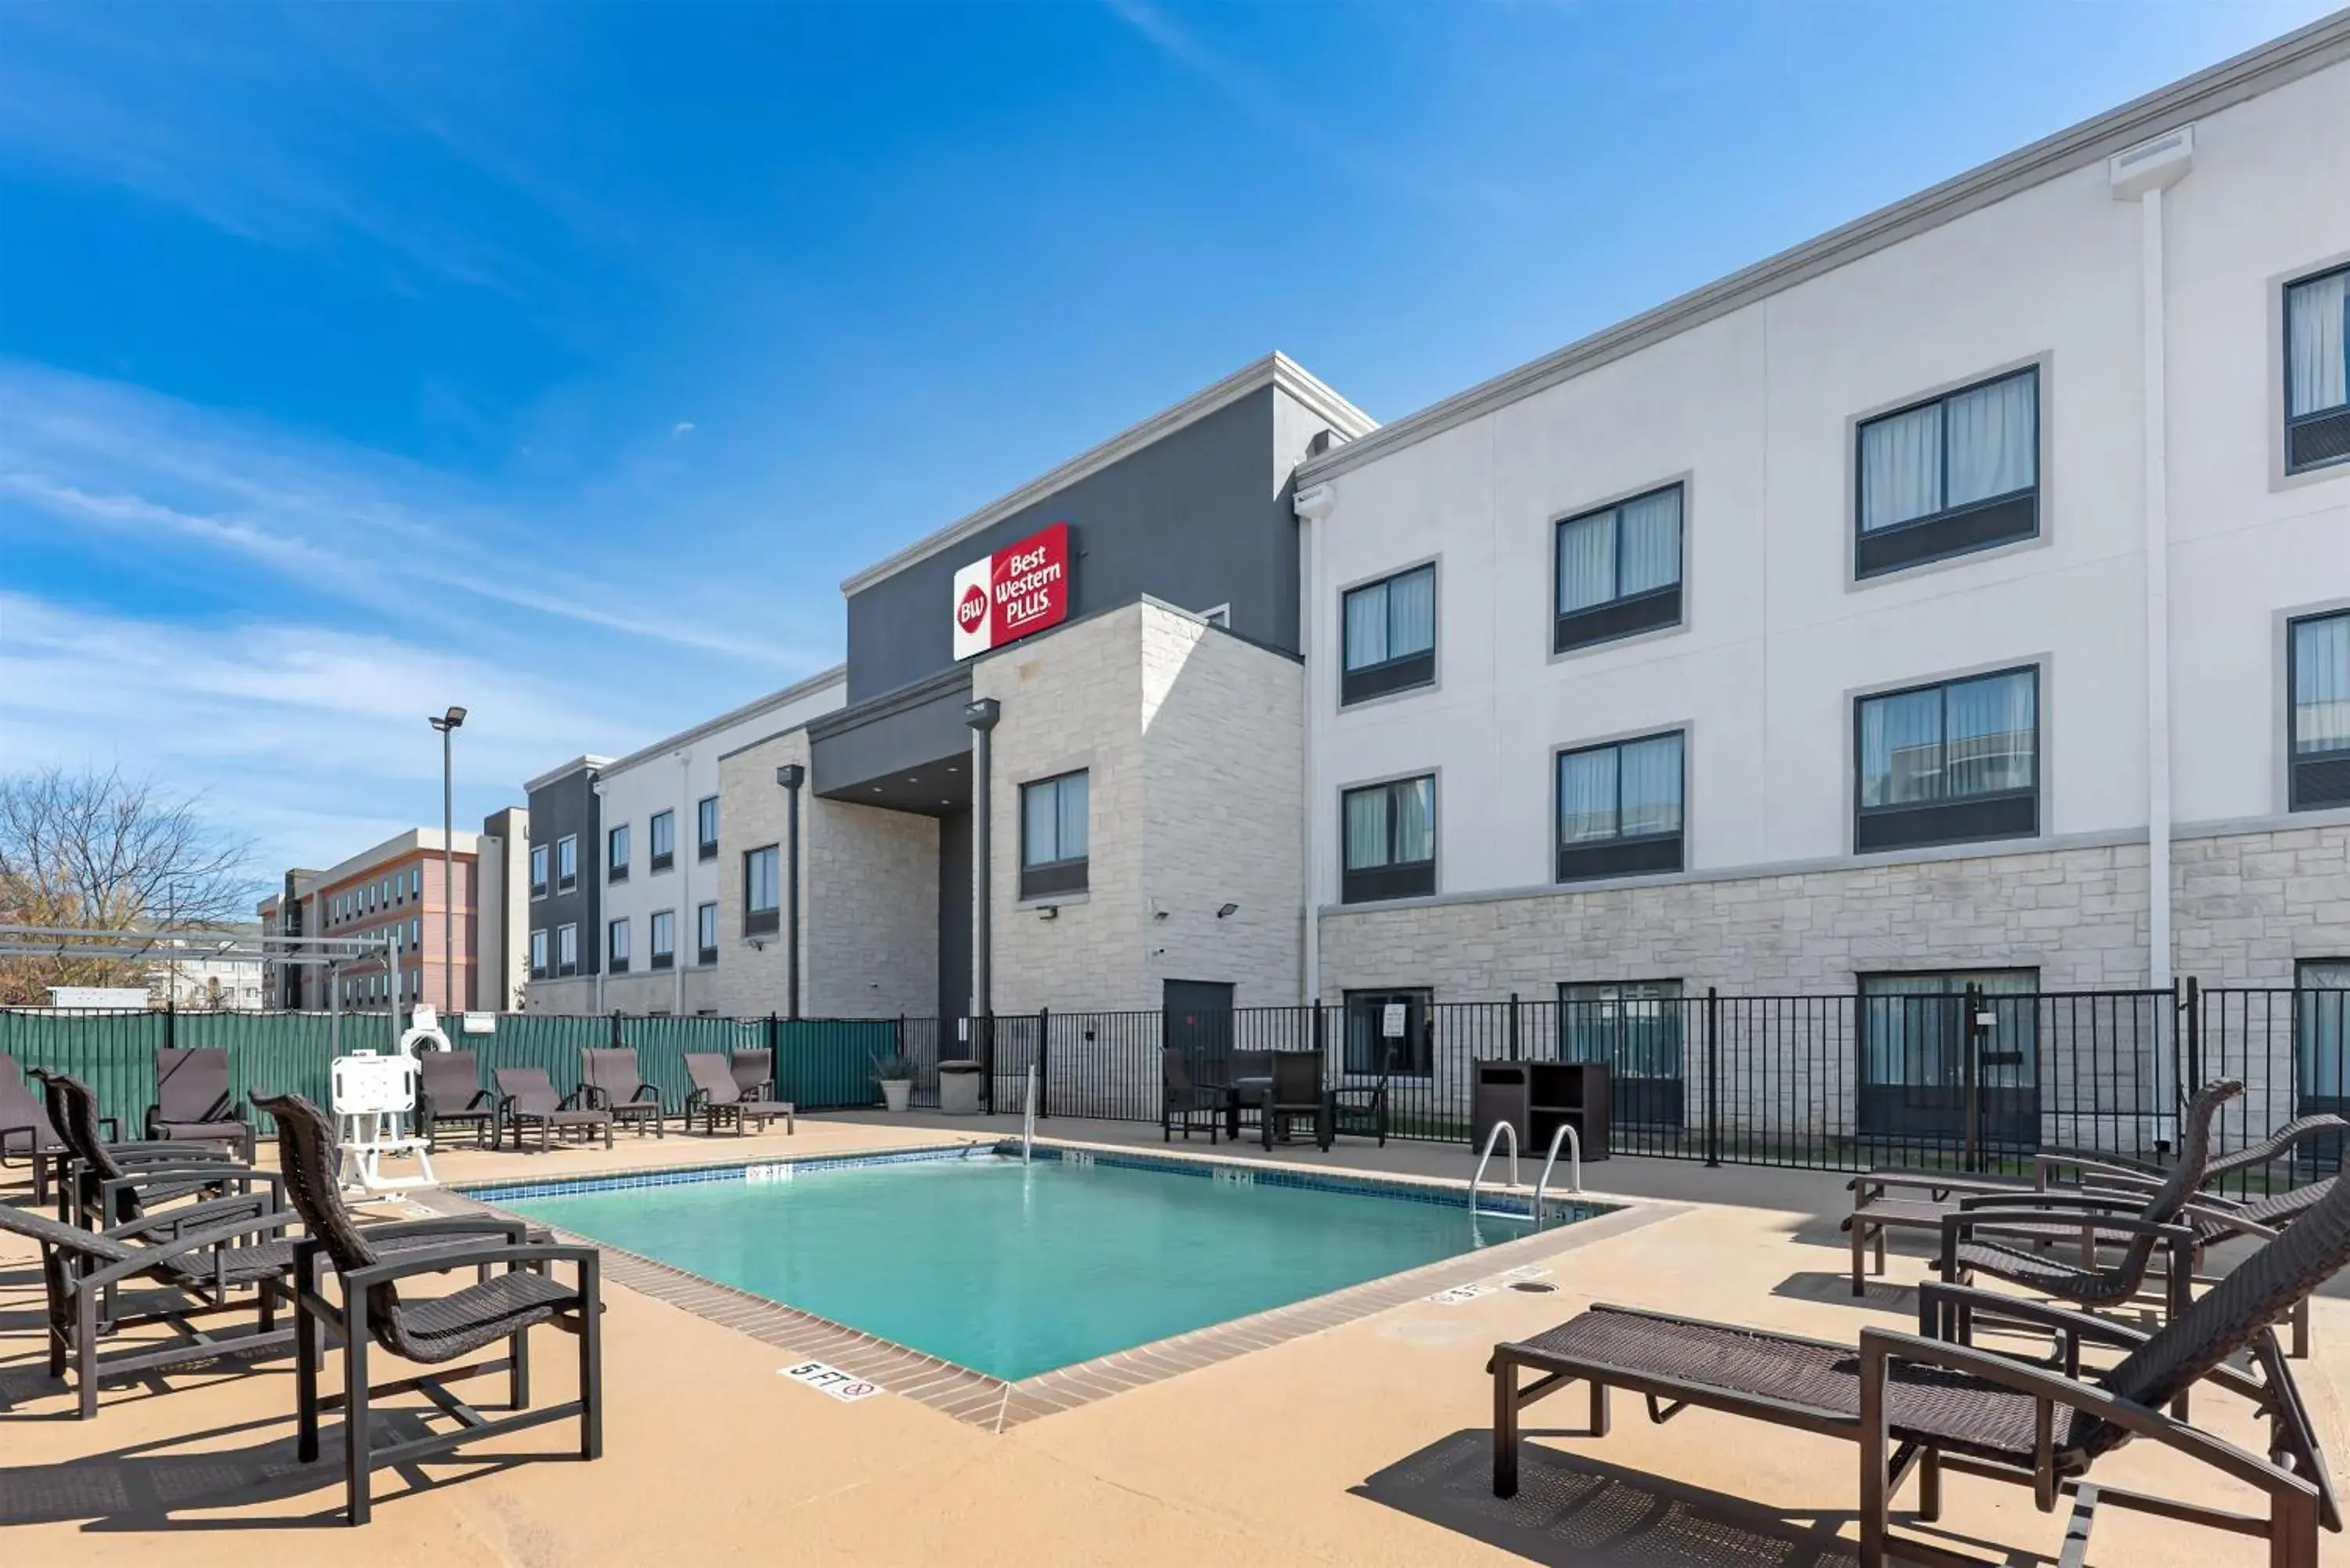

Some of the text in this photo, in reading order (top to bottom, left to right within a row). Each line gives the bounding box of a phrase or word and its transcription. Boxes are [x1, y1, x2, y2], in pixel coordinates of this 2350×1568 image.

[1010, 545, 1046, 577] Best
[996, 563, 1061, 605] Western
[961, 596, 985, 623] BW
[1007, 588, 1050, 623] PLUS
[790, 1363, 852, 1387] 5 FT
